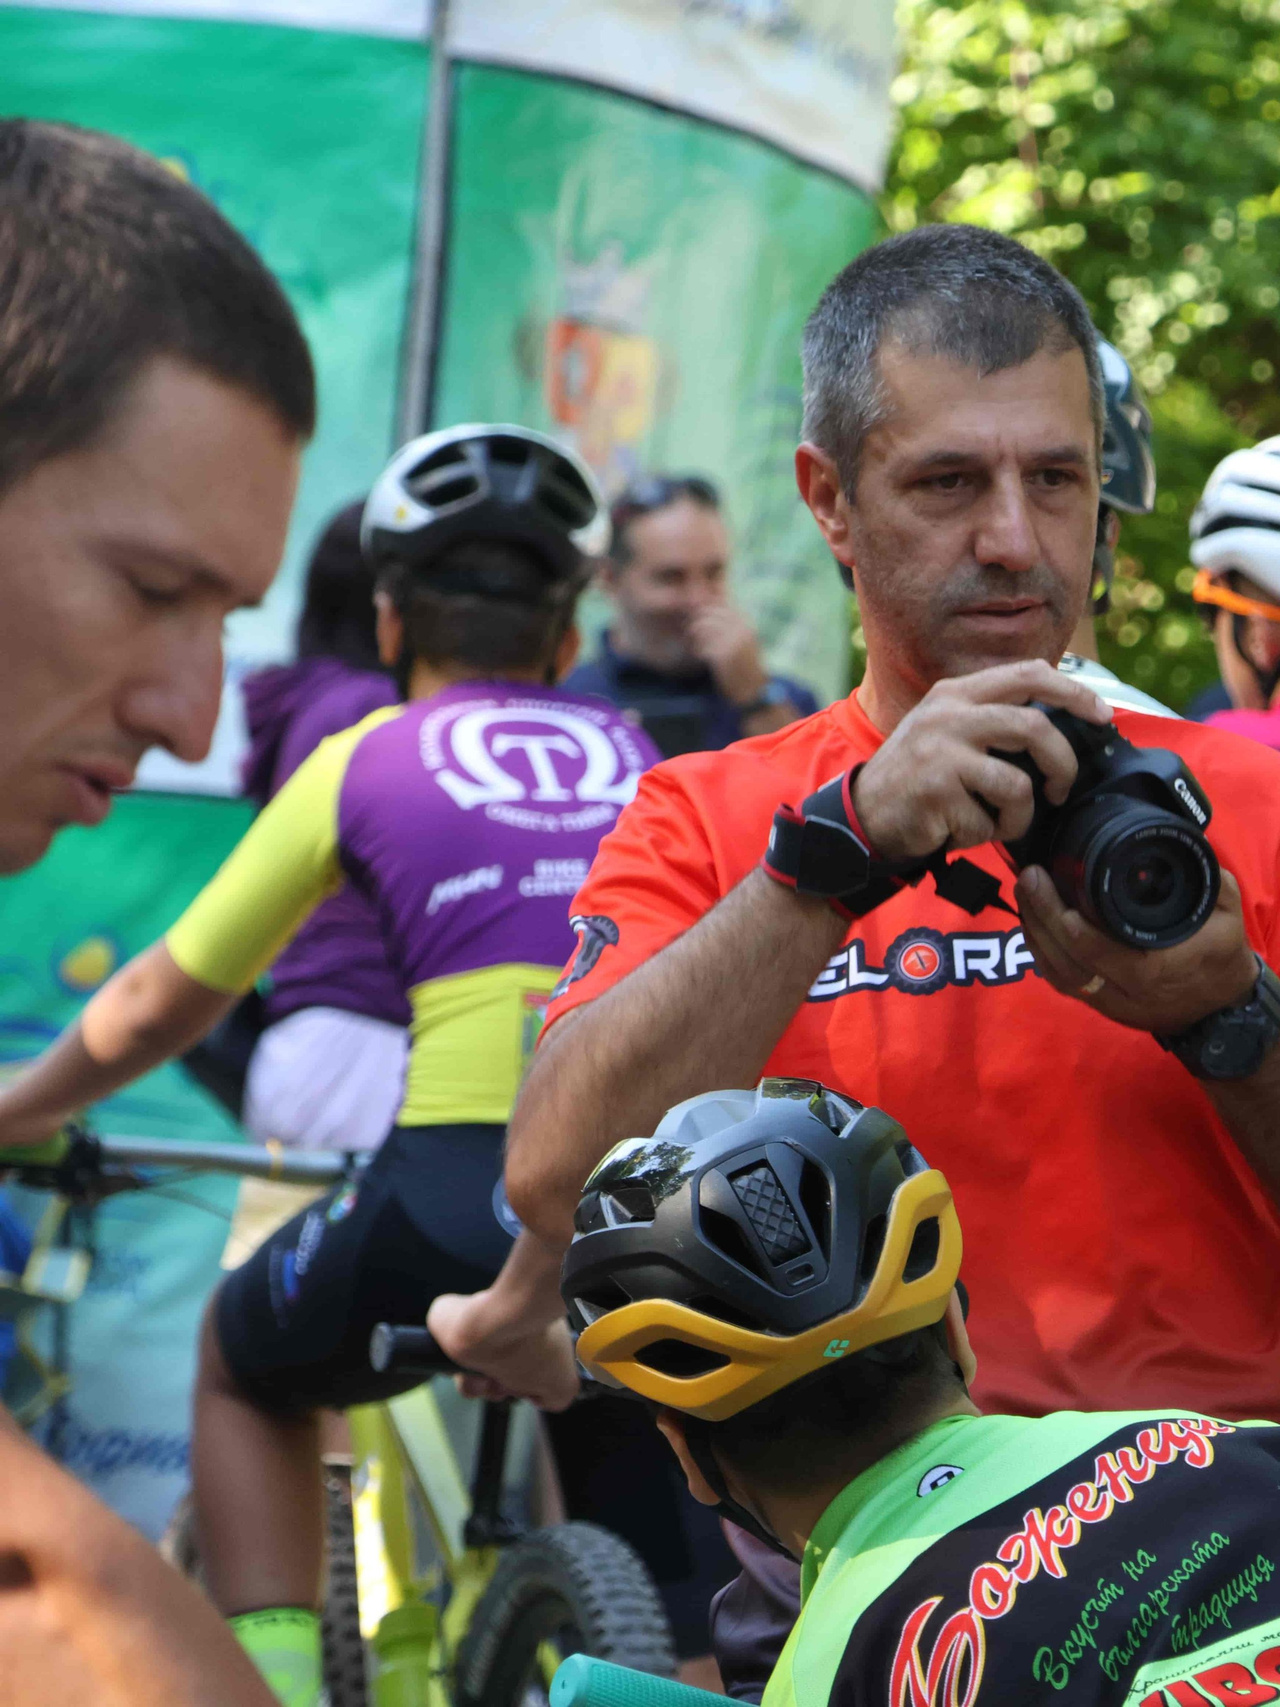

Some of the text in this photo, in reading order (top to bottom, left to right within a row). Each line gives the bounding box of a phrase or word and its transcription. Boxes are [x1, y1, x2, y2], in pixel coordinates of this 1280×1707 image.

[1174, 777, 1207, 825] Canon
[1121, 1548, 1157, 1582] на
[1171, 1553, 1276, 1652] традиция
